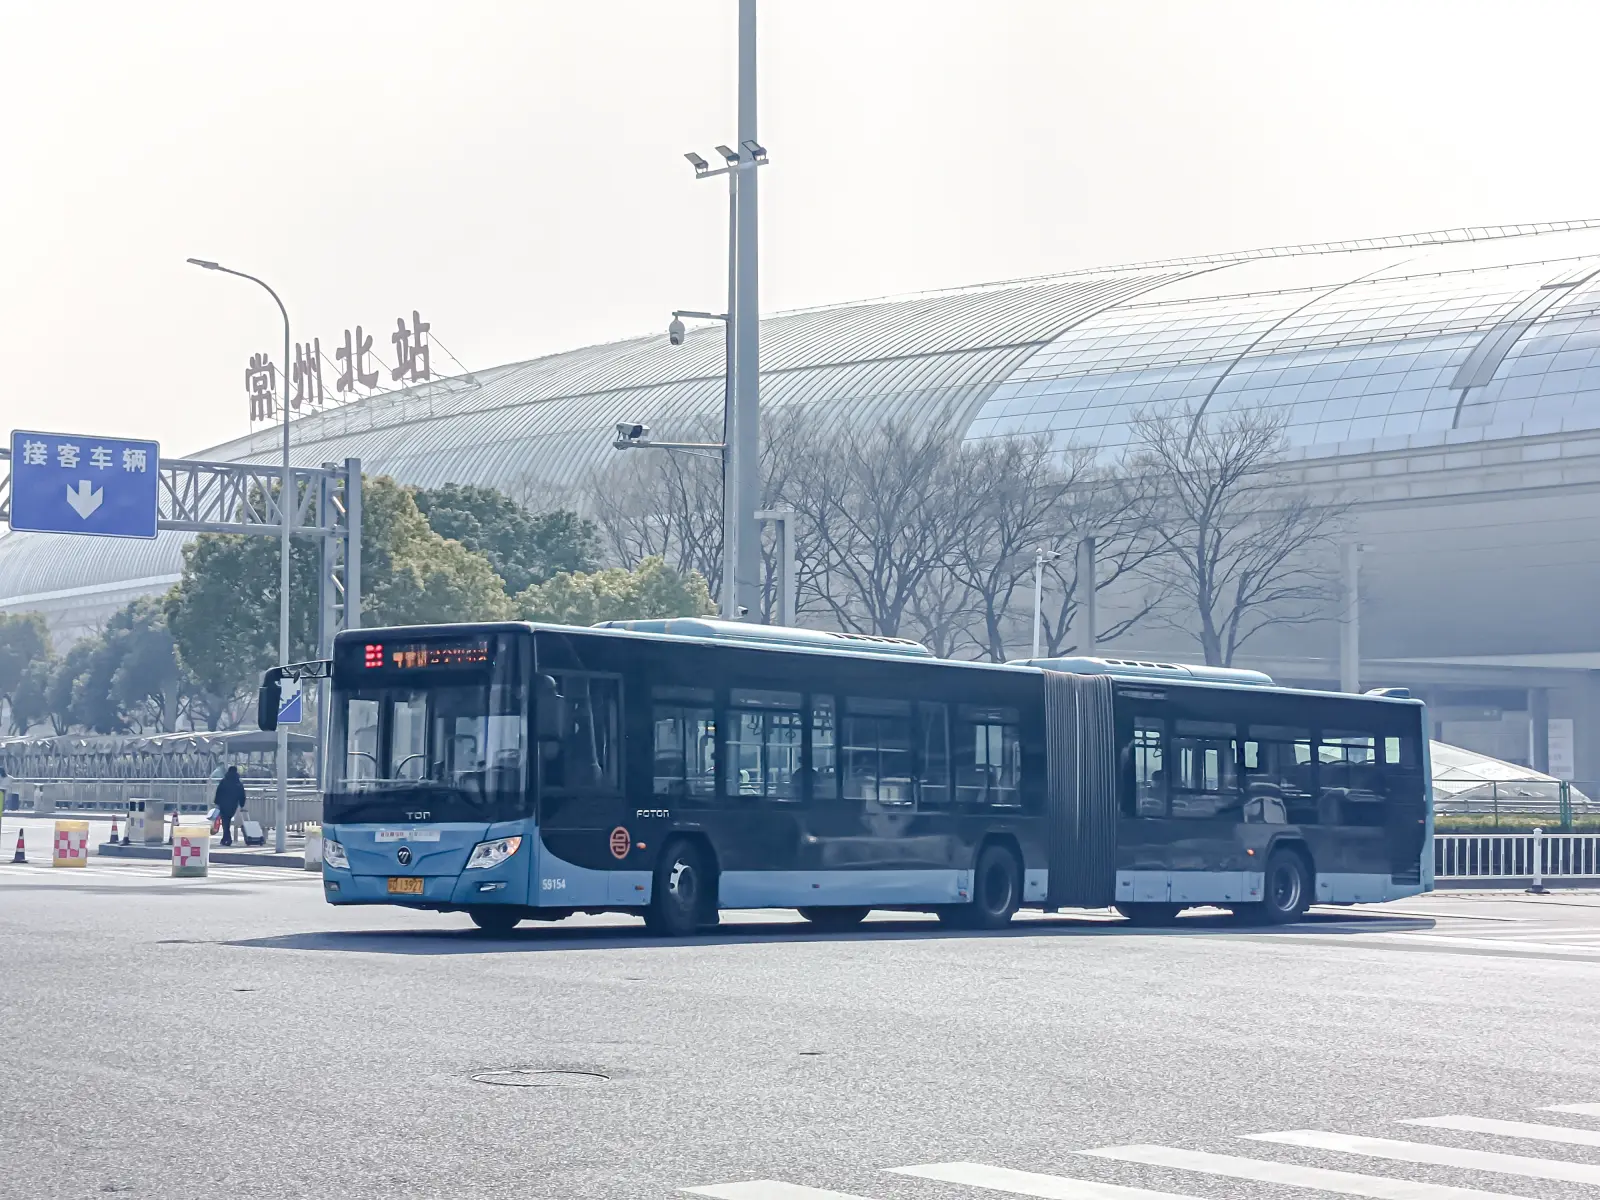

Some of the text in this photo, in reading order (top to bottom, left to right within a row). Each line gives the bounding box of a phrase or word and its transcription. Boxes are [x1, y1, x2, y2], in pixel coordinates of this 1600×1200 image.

[245, 310, 431, 422] 常州北站
[23, 439, 147, 473] 接客车辆
[636, 809, 670, 819] FOTON
[541, 878, 566, 891] 59154
